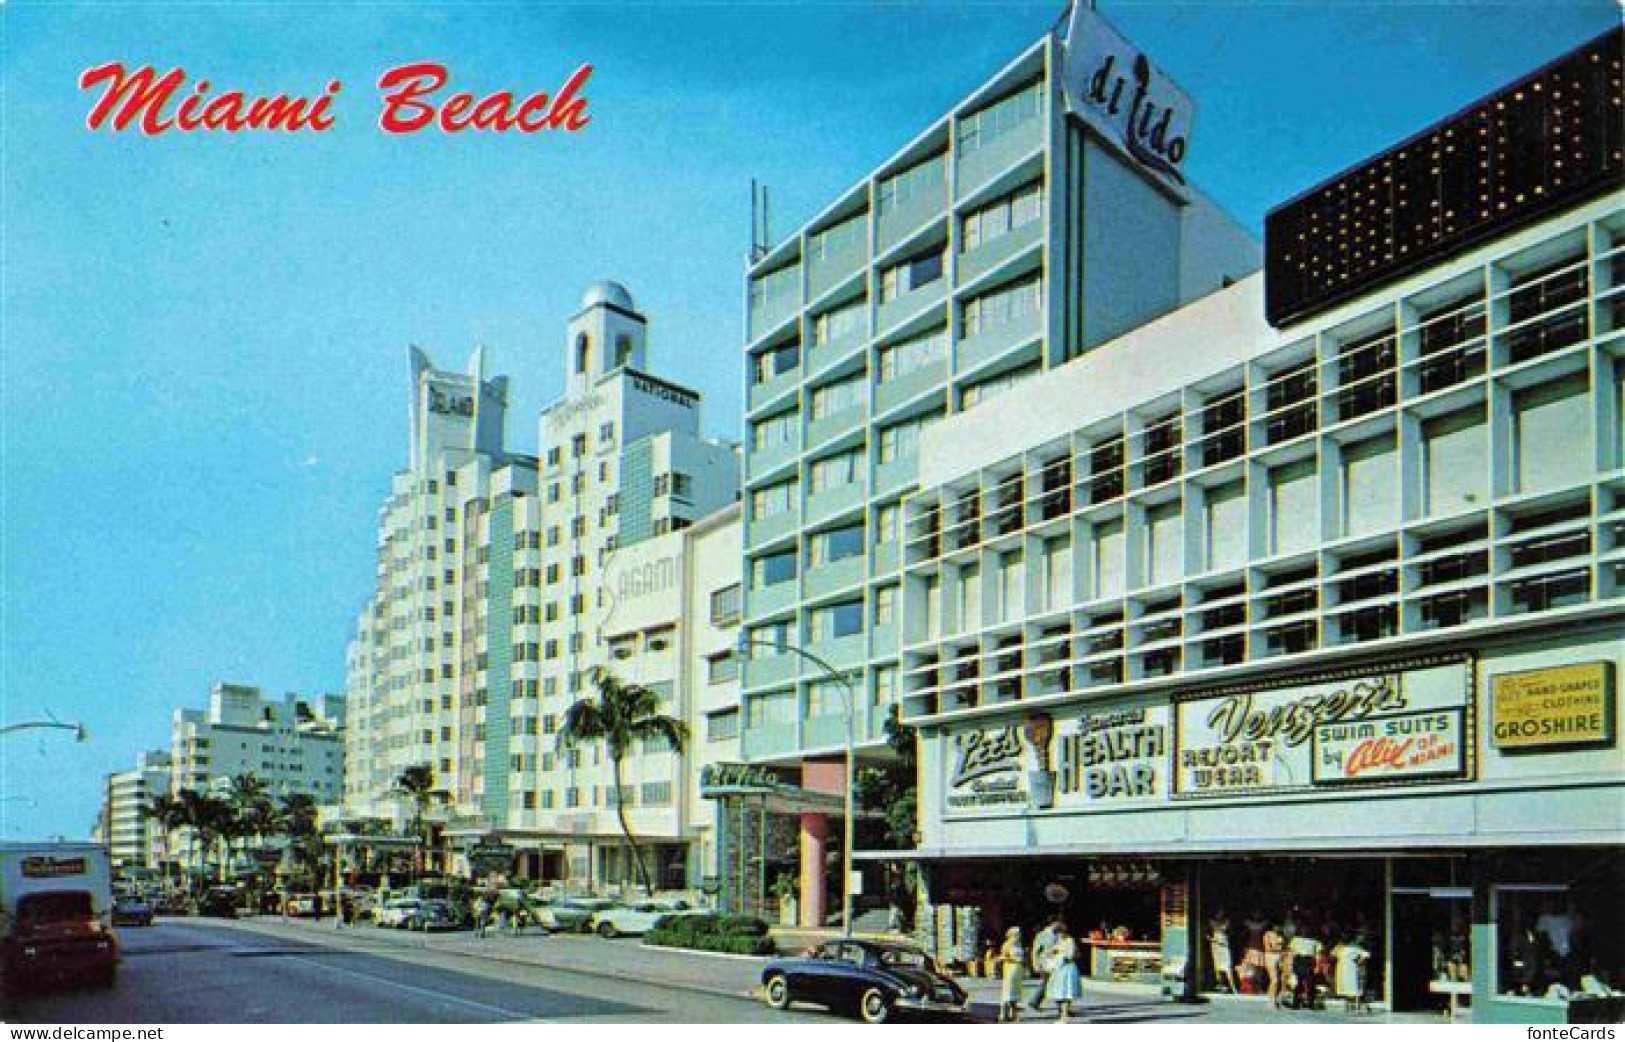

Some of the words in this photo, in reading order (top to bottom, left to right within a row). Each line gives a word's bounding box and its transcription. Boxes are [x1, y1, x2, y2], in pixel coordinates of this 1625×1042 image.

[1320, 724, 1375, 743] SWIM
[1385, 714, 1449, 735] SUITS
[1495, 713, 1599, 739] GROSHIRE
[1058, 724, 1165, 795] HEALTH
[1183, 742, 1273, 767] RESORT
[1322, 747, 1343, 769] by
[1086, 765, 1156, 799] BAR
[1192, 766, 1263, 787] WEAR
